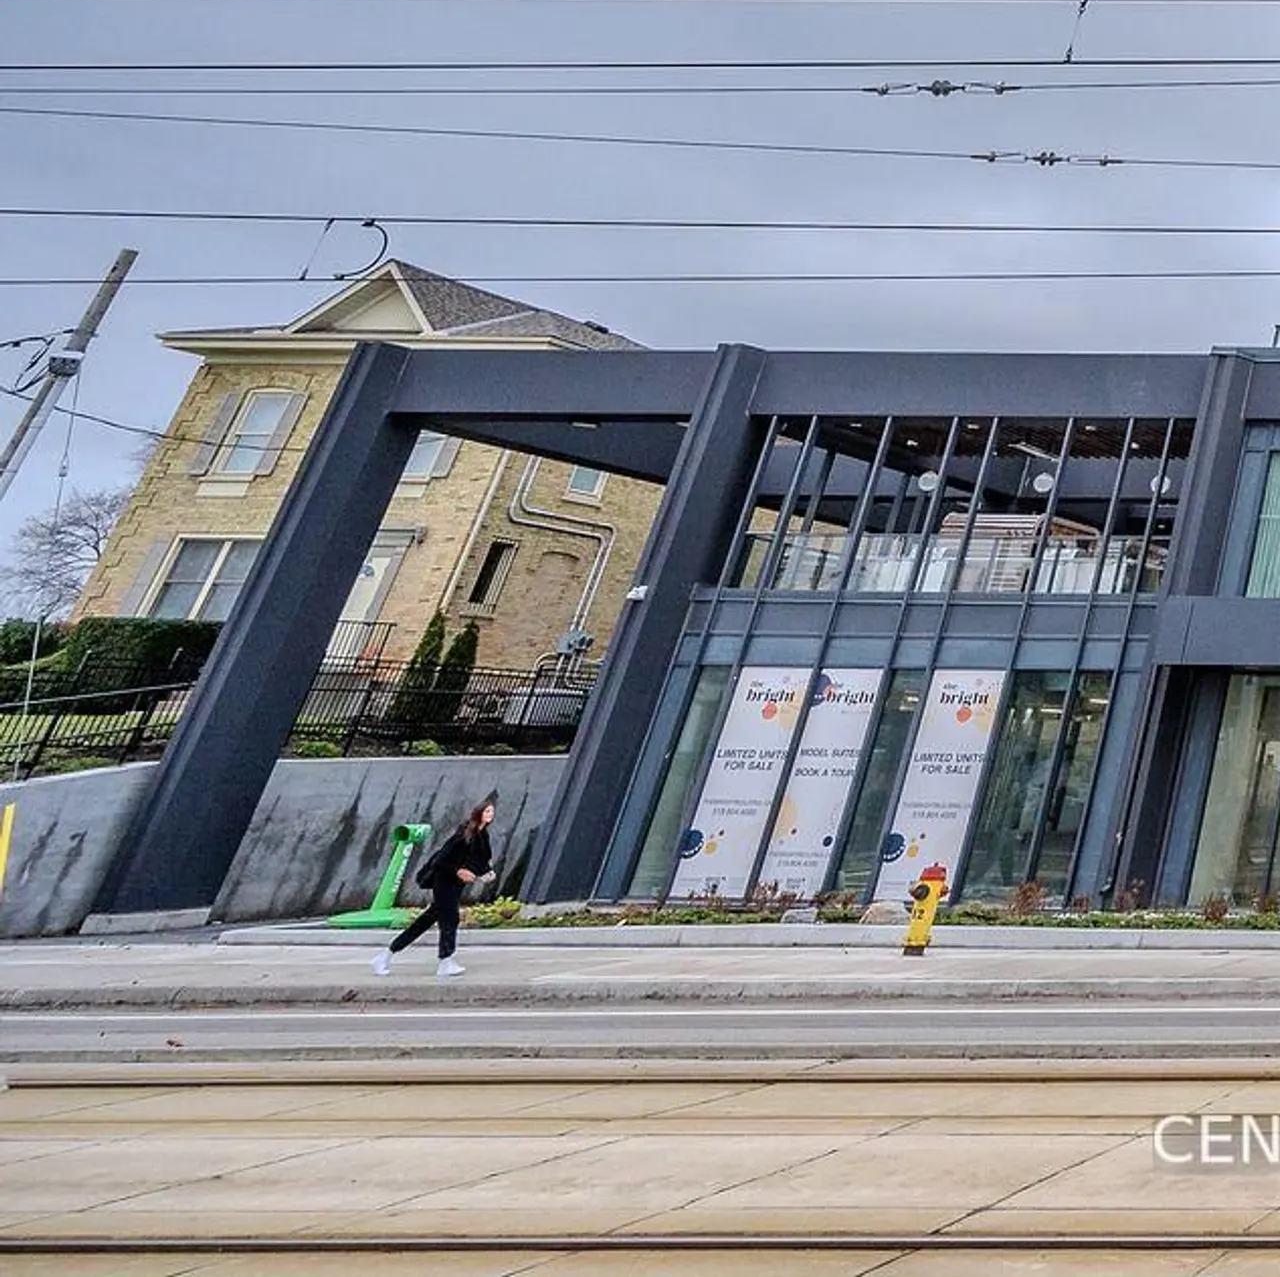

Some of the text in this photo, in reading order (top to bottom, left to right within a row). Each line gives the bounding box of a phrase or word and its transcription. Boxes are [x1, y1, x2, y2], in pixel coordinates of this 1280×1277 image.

[745, 688, 796, 704] bright
[826, 689, 875, 706] bright
[939, 690, 989, 706] bright
[716, 748, 757, 759] LIMITED
[914, 753, 953, 763] LIMITED
[723, 760, 774, 771] FOR SALE
[921, 764, 971, 775] FOR SALE
[794, 767, 820, 777] BOOK
[820, 767, 829, 777] A
